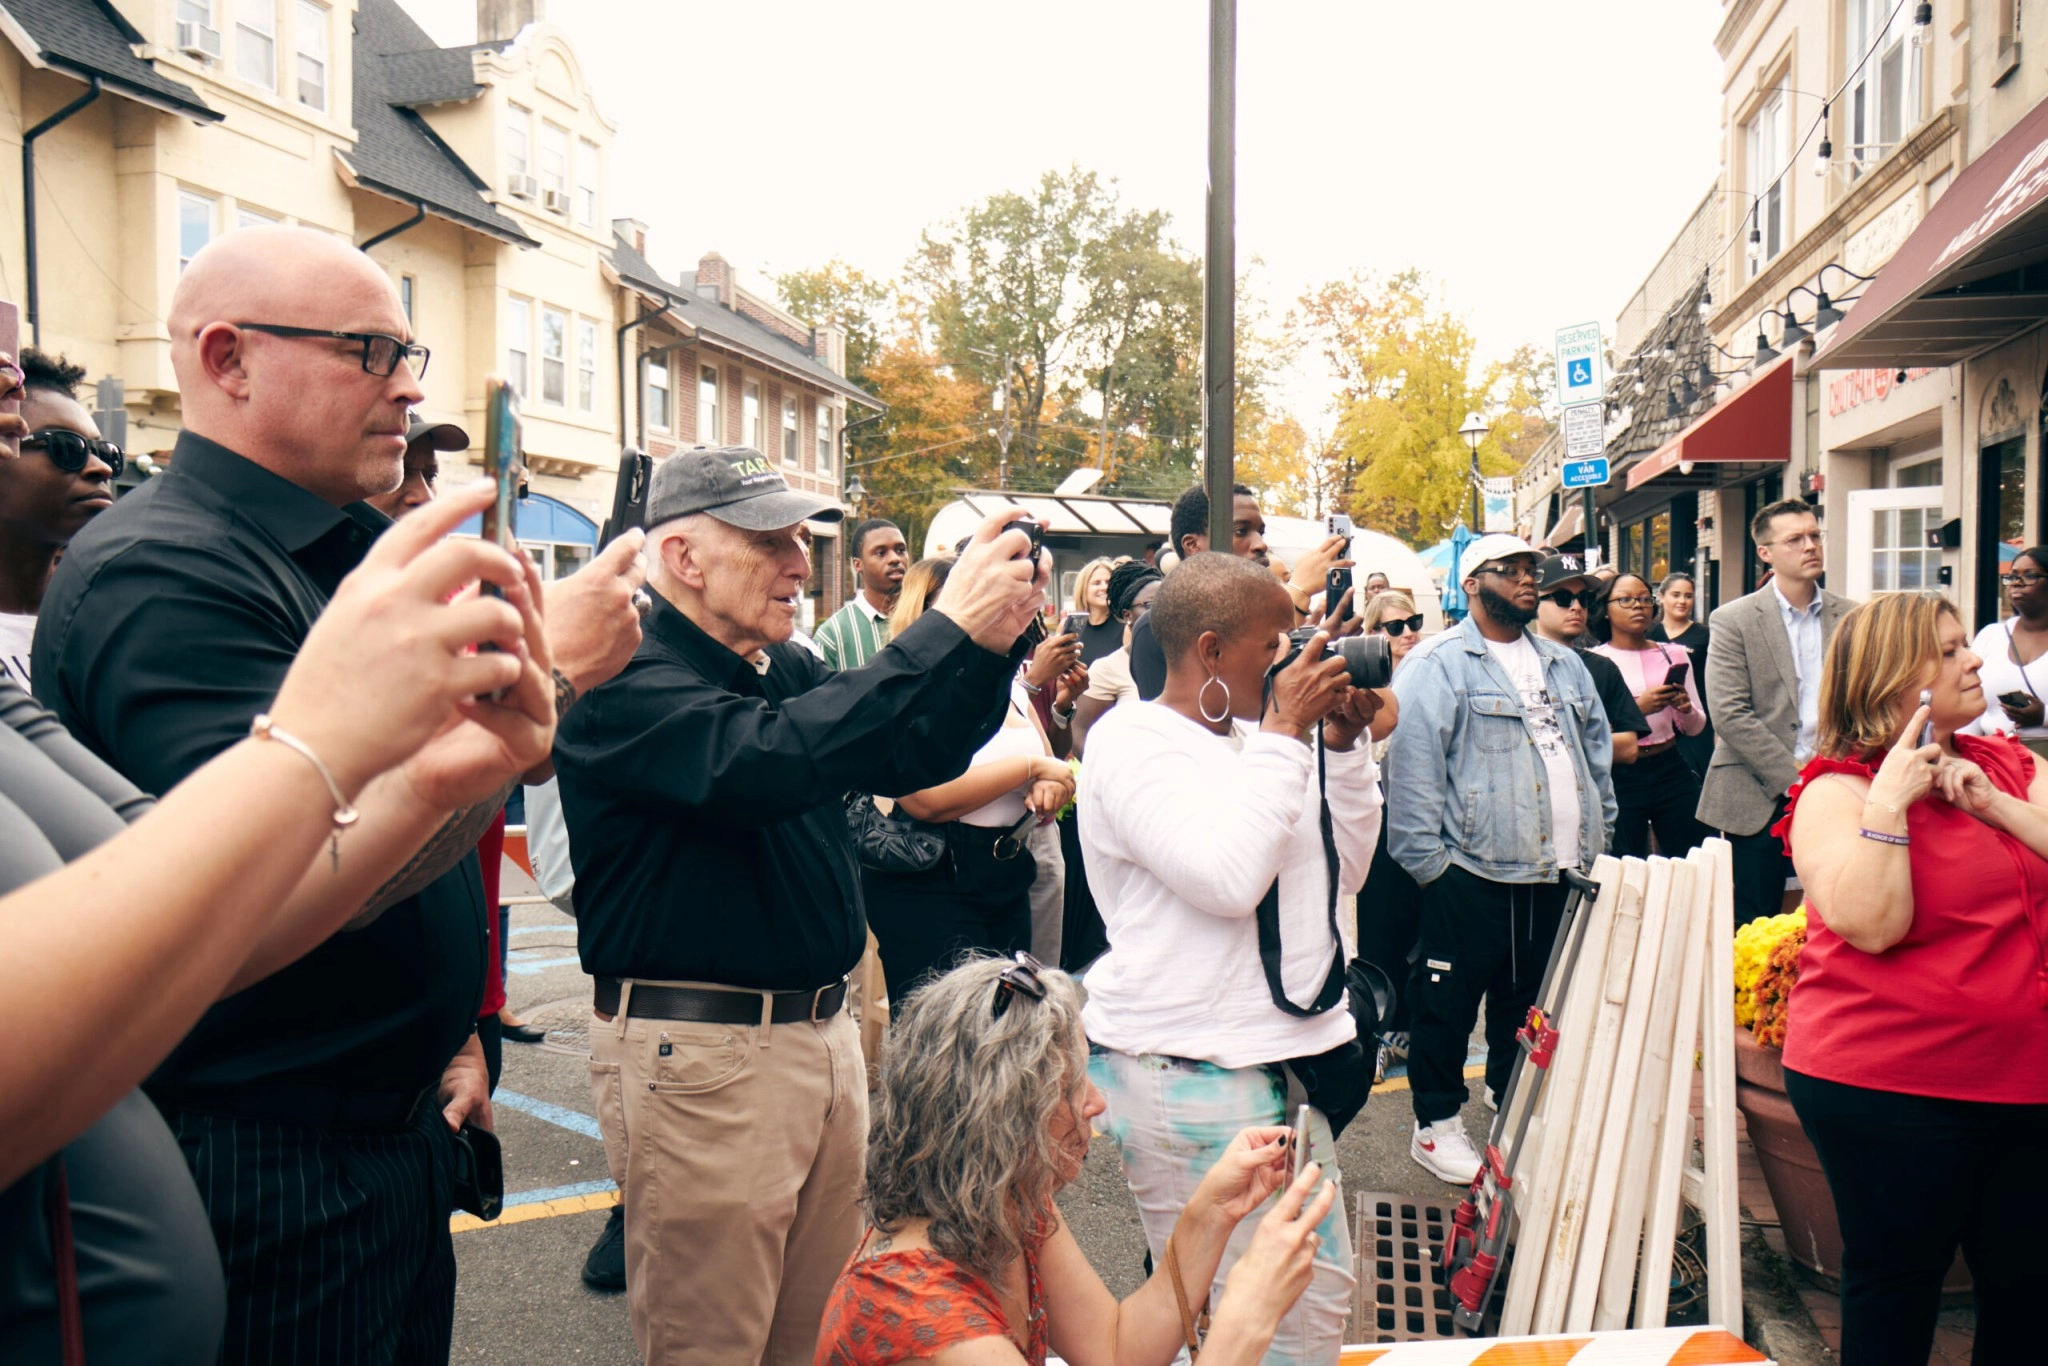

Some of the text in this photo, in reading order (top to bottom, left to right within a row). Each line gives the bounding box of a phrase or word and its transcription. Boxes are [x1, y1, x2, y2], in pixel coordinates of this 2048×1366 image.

[1557, 329, 1598, 344] RESERVED
[1561, 343, 1596, 358] PARKING
[1578, 465, 1595, 474] VAN
[1570, 472, 1603, 482] ACCESSIBLE
